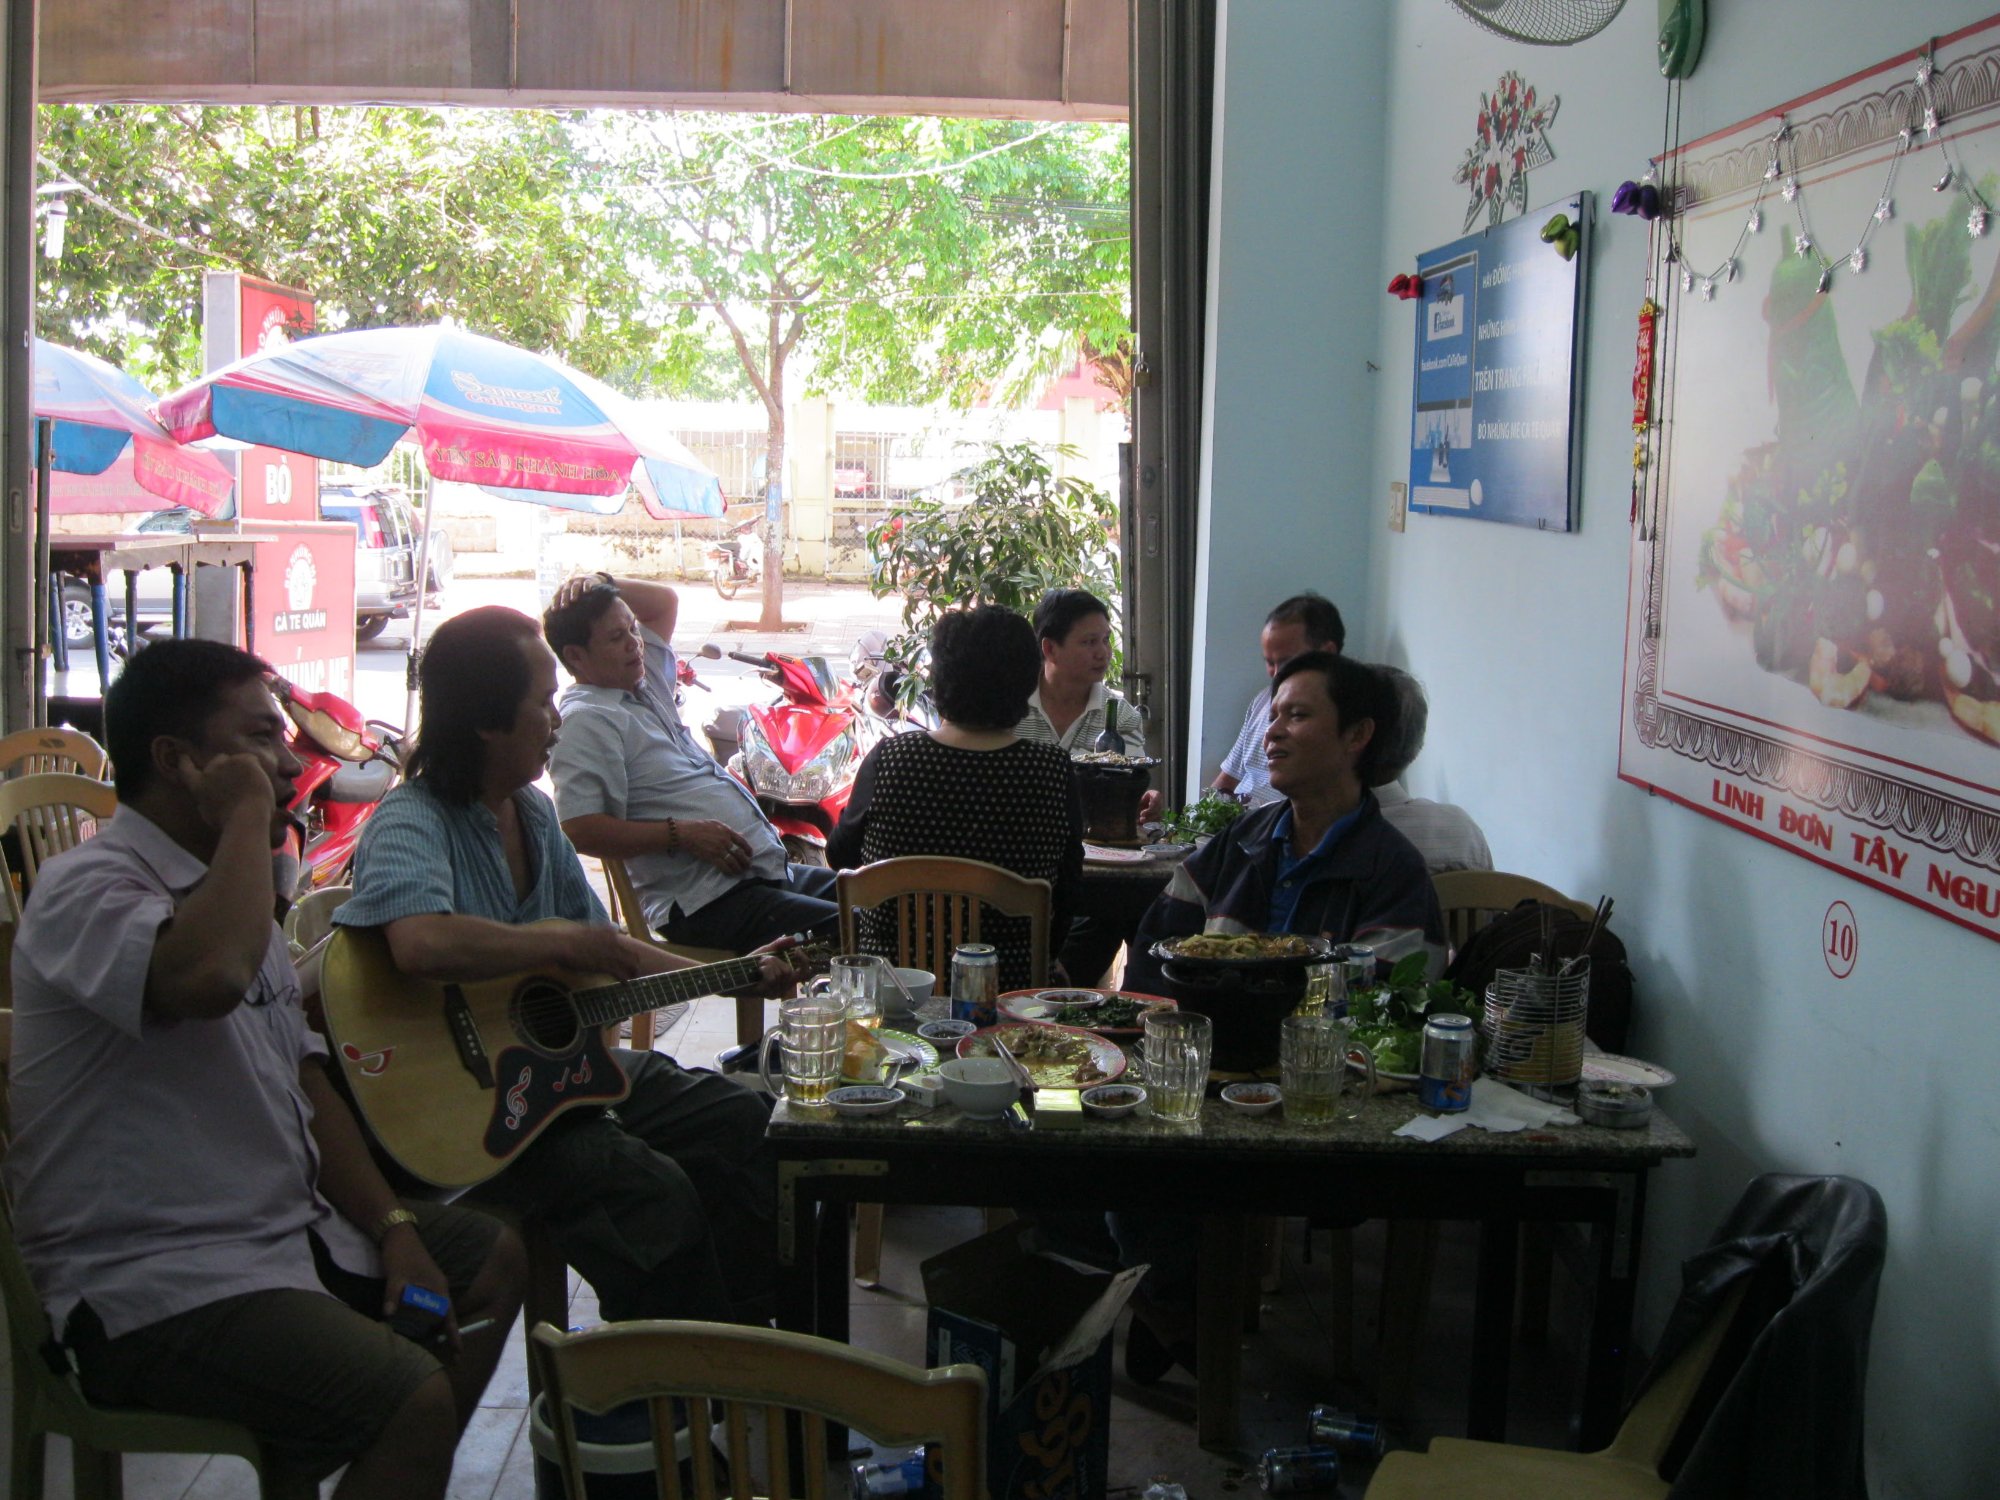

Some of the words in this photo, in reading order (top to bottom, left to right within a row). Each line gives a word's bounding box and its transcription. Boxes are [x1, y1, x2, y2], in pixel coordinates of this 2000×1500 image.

[264, 454, 293, 505] BÒ
[275, 611, 288, 633] CÀ
[290, 614, 301, 631] TE
[302, 610, 326, 629] QUÁN
[1712, 779, 1764, 821] LINH
[1778, 805, 1833, 851] ĐƠN
[1851, 832, 1909, 879] TÂY
[1927, 862, 2000, 918] NGU
[1828, 919, 1854, 962] 10
